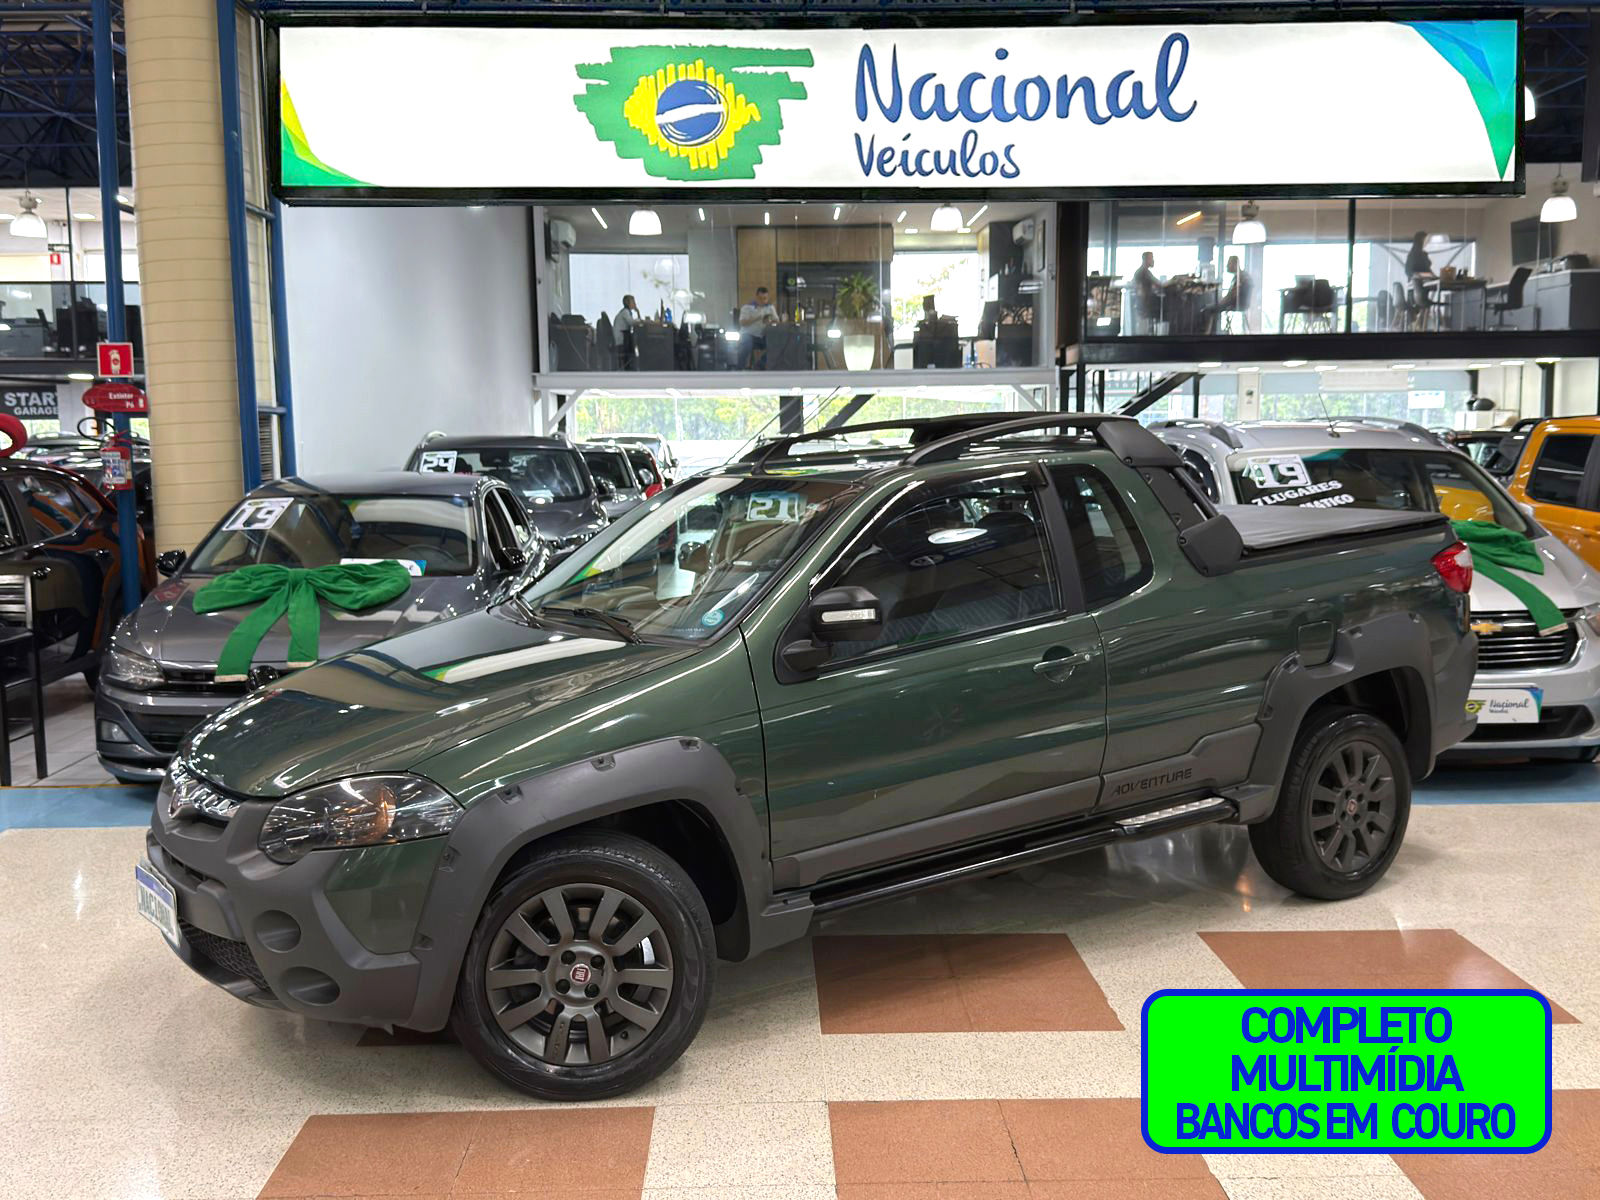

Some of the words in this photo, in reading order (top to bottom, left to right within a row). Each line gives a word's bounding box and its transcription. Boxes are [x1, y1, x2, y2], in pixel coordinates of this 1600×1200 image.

[855, 32, 1198, 125] Nacional
[854, 129, 1021, 178] Veículos
[4, 391, 58, 406] STAR
[108, 392, 134, 400] Extintor
[1252, 462, 1308, 486] 19
[226, 505, 283, 530] 19
[749, 497, 792, 520] 21
[1112, 767, 1193, 796] ADVENTURE
